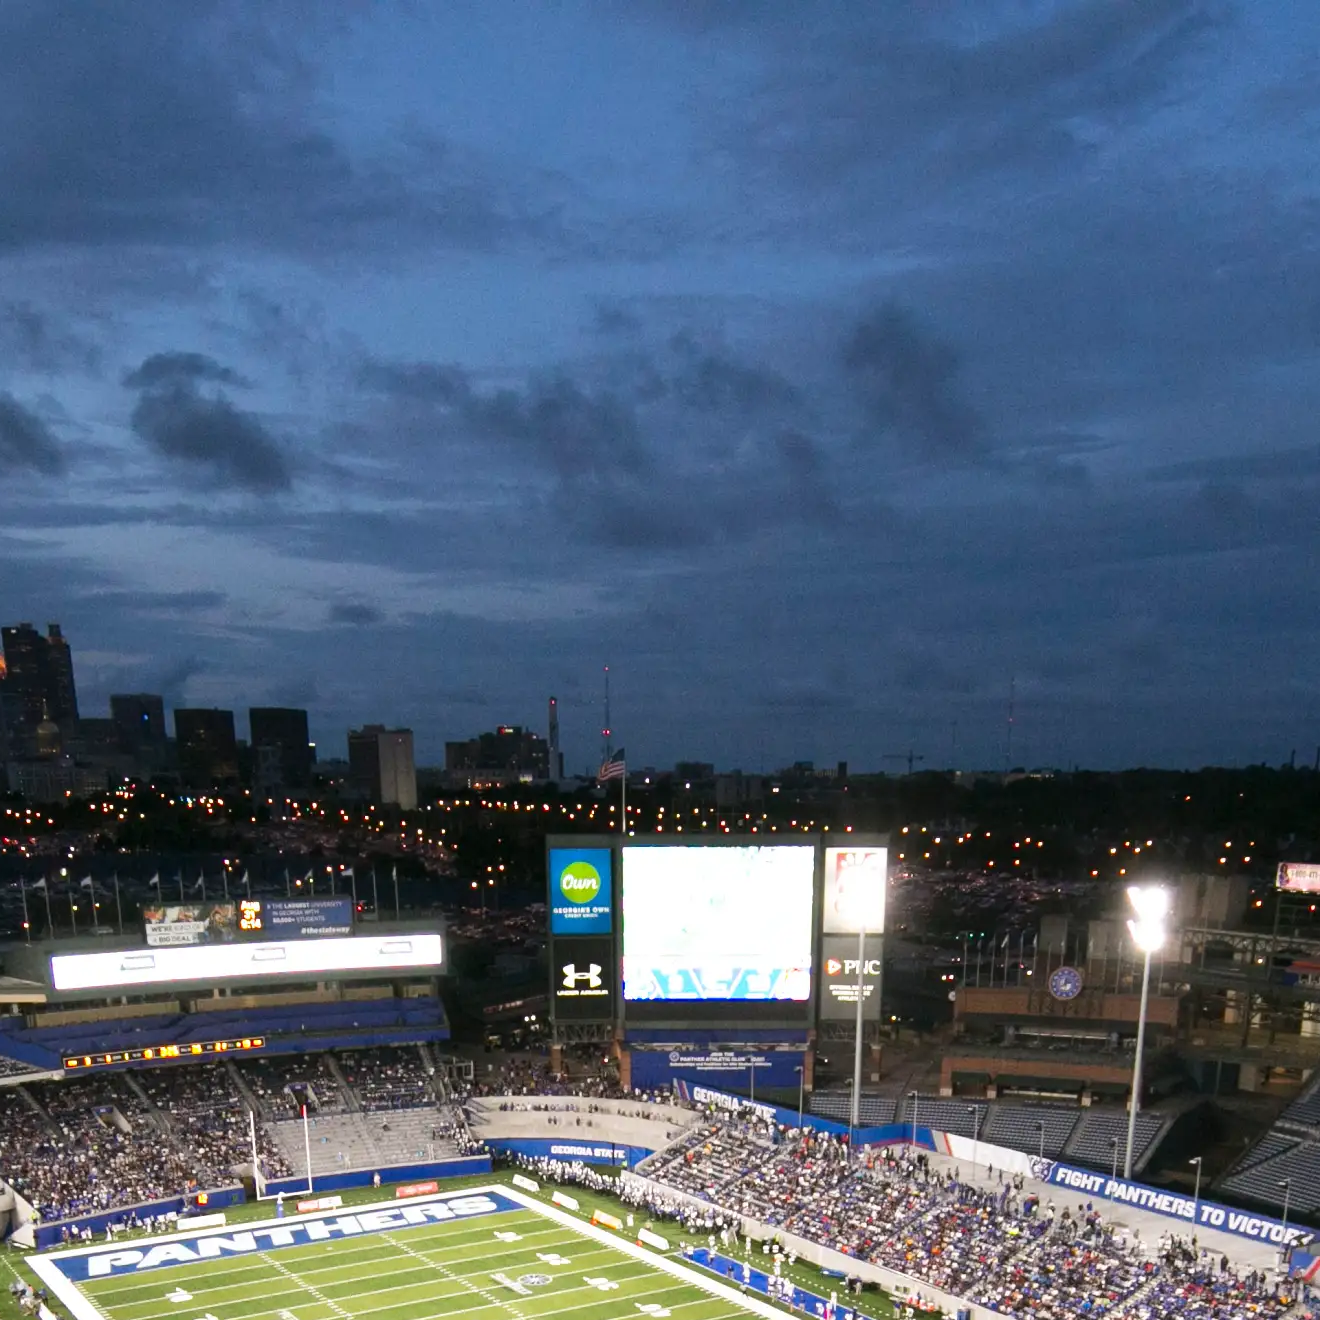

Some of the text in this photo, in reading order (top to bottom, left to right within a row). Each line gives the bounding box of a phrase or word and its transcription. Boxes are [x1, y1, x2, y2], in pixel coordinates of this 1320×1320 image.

[562, 874, 598, 891] Own
[844, 959, 880, 975] PNC
[693, 1086, 740, 1112] GEORGIA
[551, 1145, 626, 1158] GEORGIA STATE
[1056, 1167, 1104, 1193] FIGHT
[1108, 1180, 1195, 1218] PANTHERS
[1200, 1205, 1226, 1226] TO
[88, 1197, 497, 1276] PANTHERS
